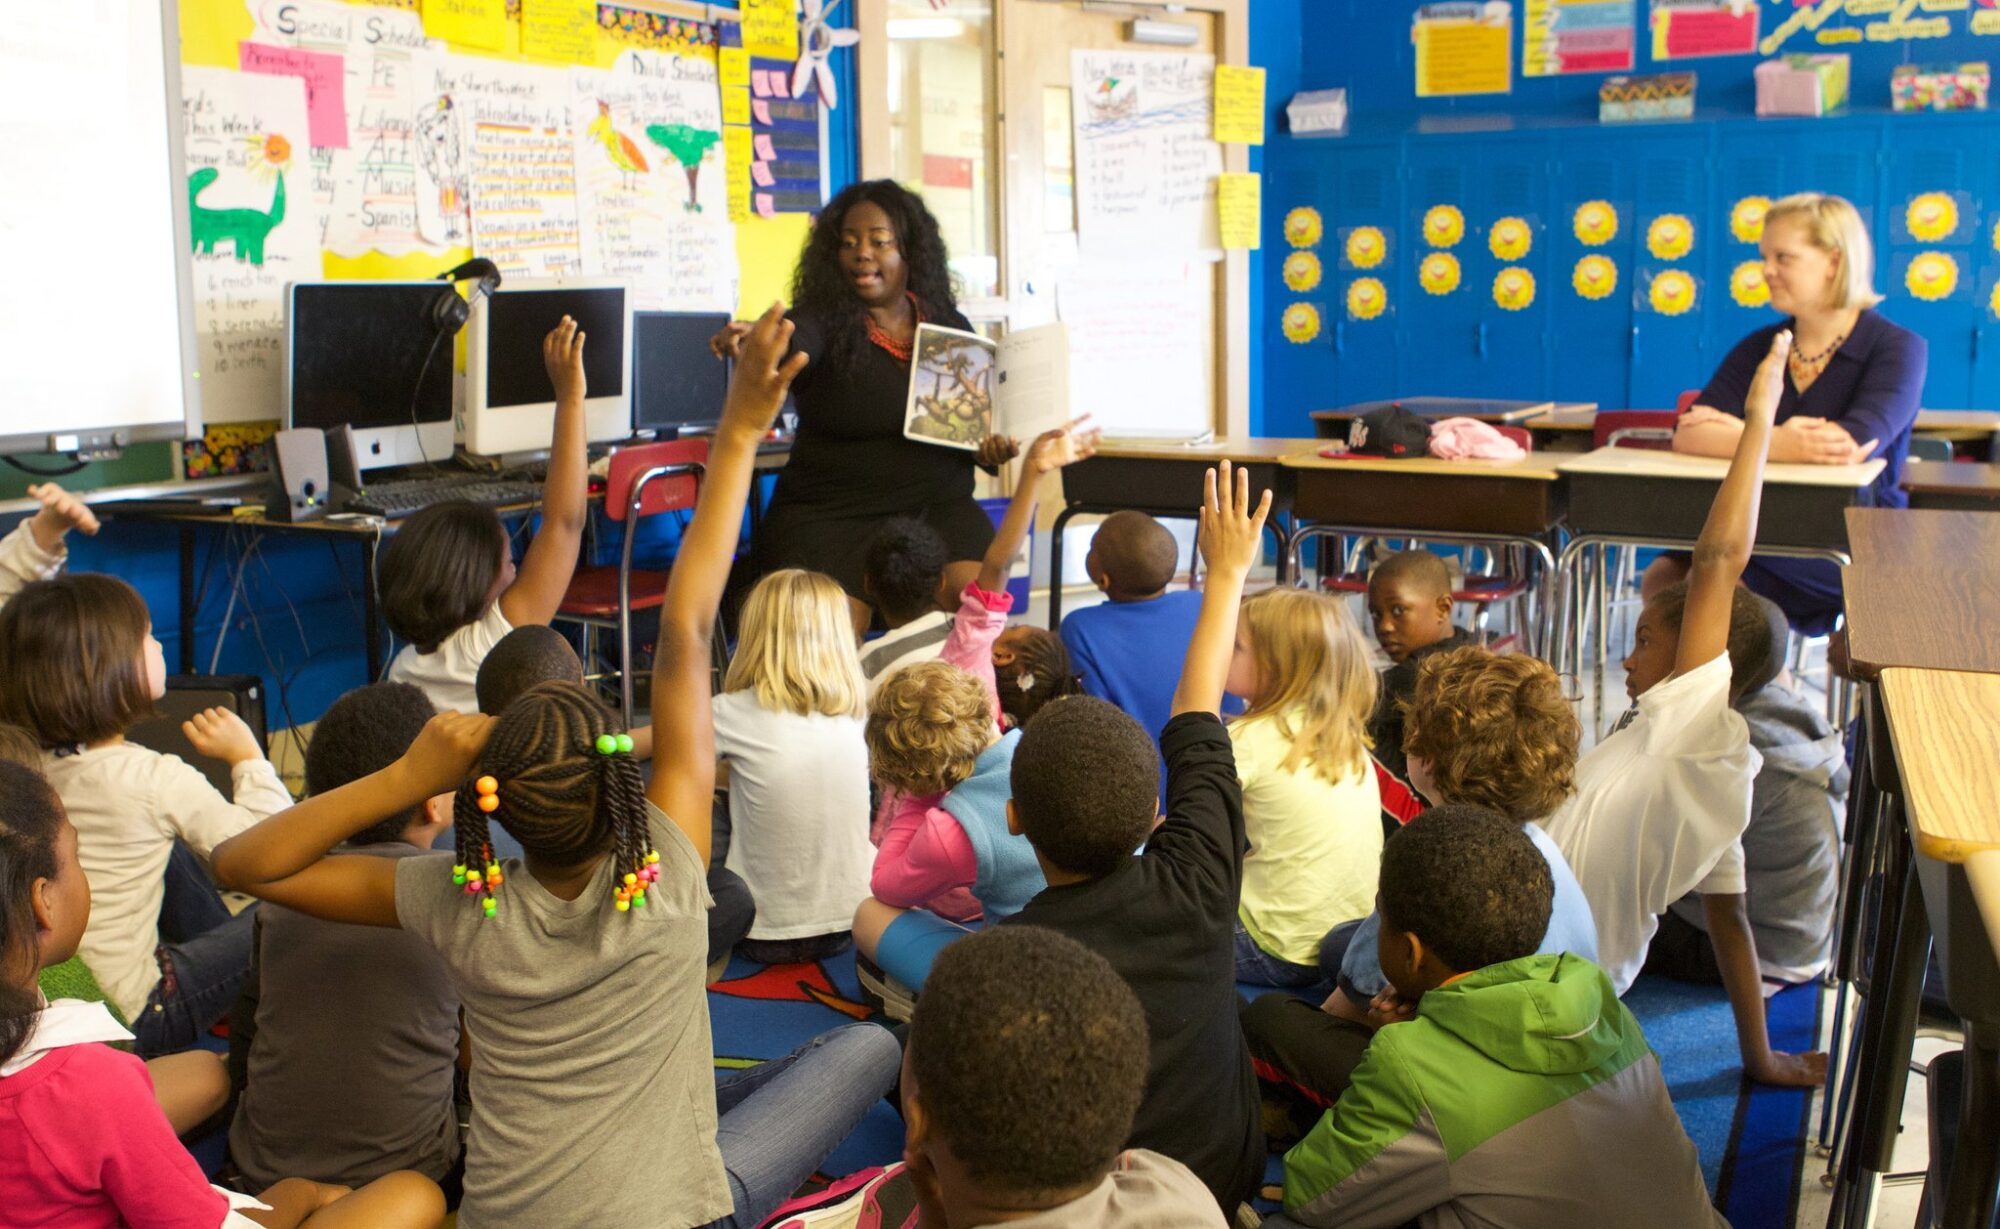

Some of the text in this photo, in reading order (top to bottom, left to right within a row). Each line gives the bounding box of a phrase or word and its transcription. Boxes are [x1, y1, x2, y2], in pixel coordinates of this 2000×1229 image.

[277, 5, 353, 48] Special
[370, 57, 396, 88] PE
[632, 52, 667, 79] Daily
[182, 88, 216, 115] rds
[471, 98, 542, 124] Introduction
[364, 130, 408, 165] Art
[361, 200, 417, 233] Spanis
